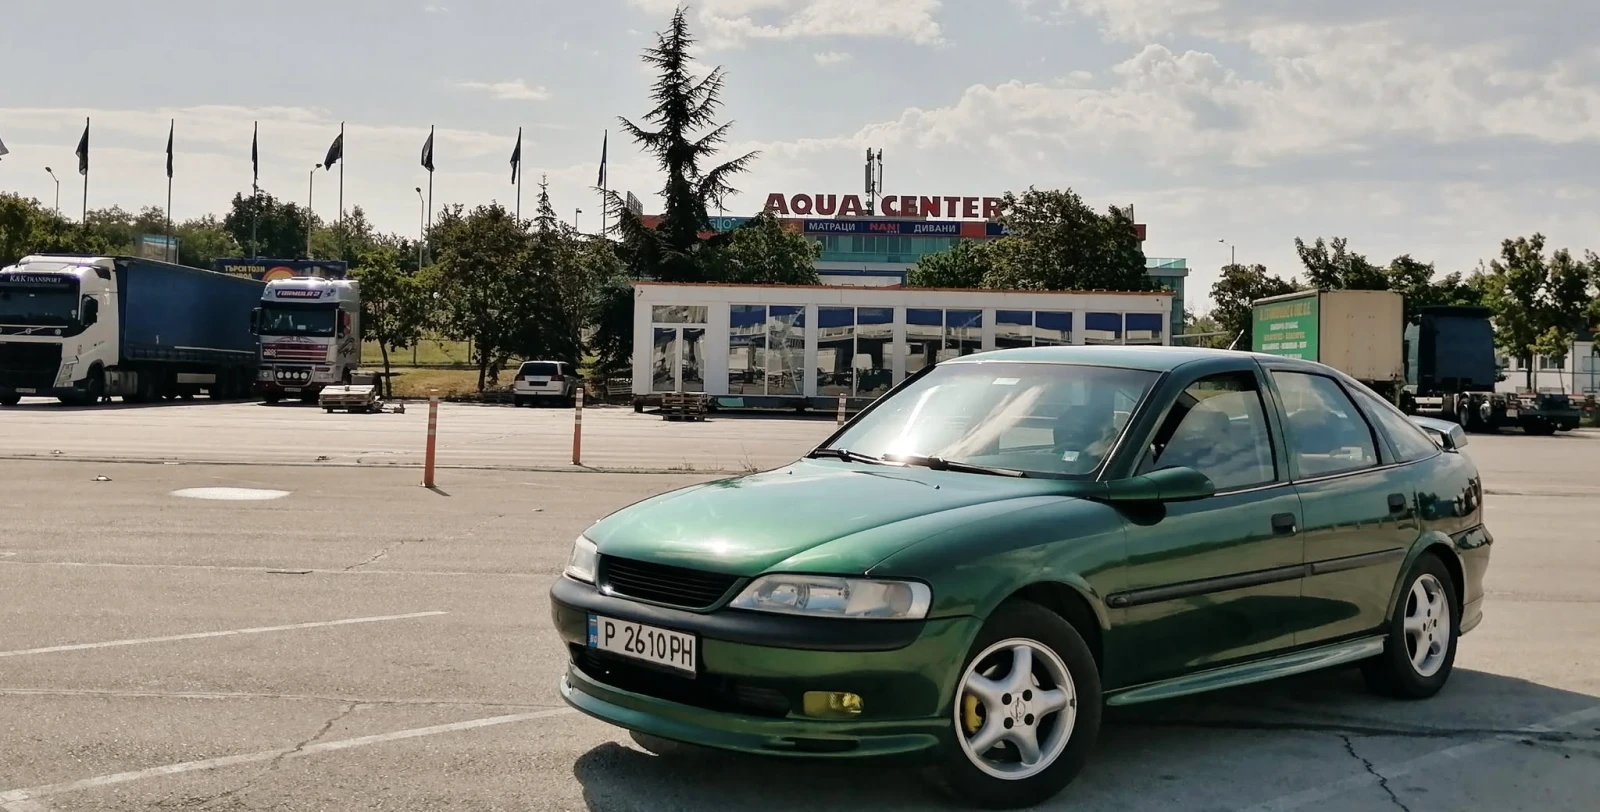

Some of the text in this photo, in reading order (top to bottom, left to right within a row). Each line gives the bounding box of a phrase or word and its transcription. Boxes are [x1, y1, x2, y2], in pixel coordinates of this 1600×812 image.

[763, 193, 1002, 218] AQUA CENTER
[808, 222, 856, 232] МАТРАЦИ
[914, 223, 956, 233] ДИВАНИ
[224, 265, 247, 273] ТЪРСИ
[604, 621, 616, 647] P
